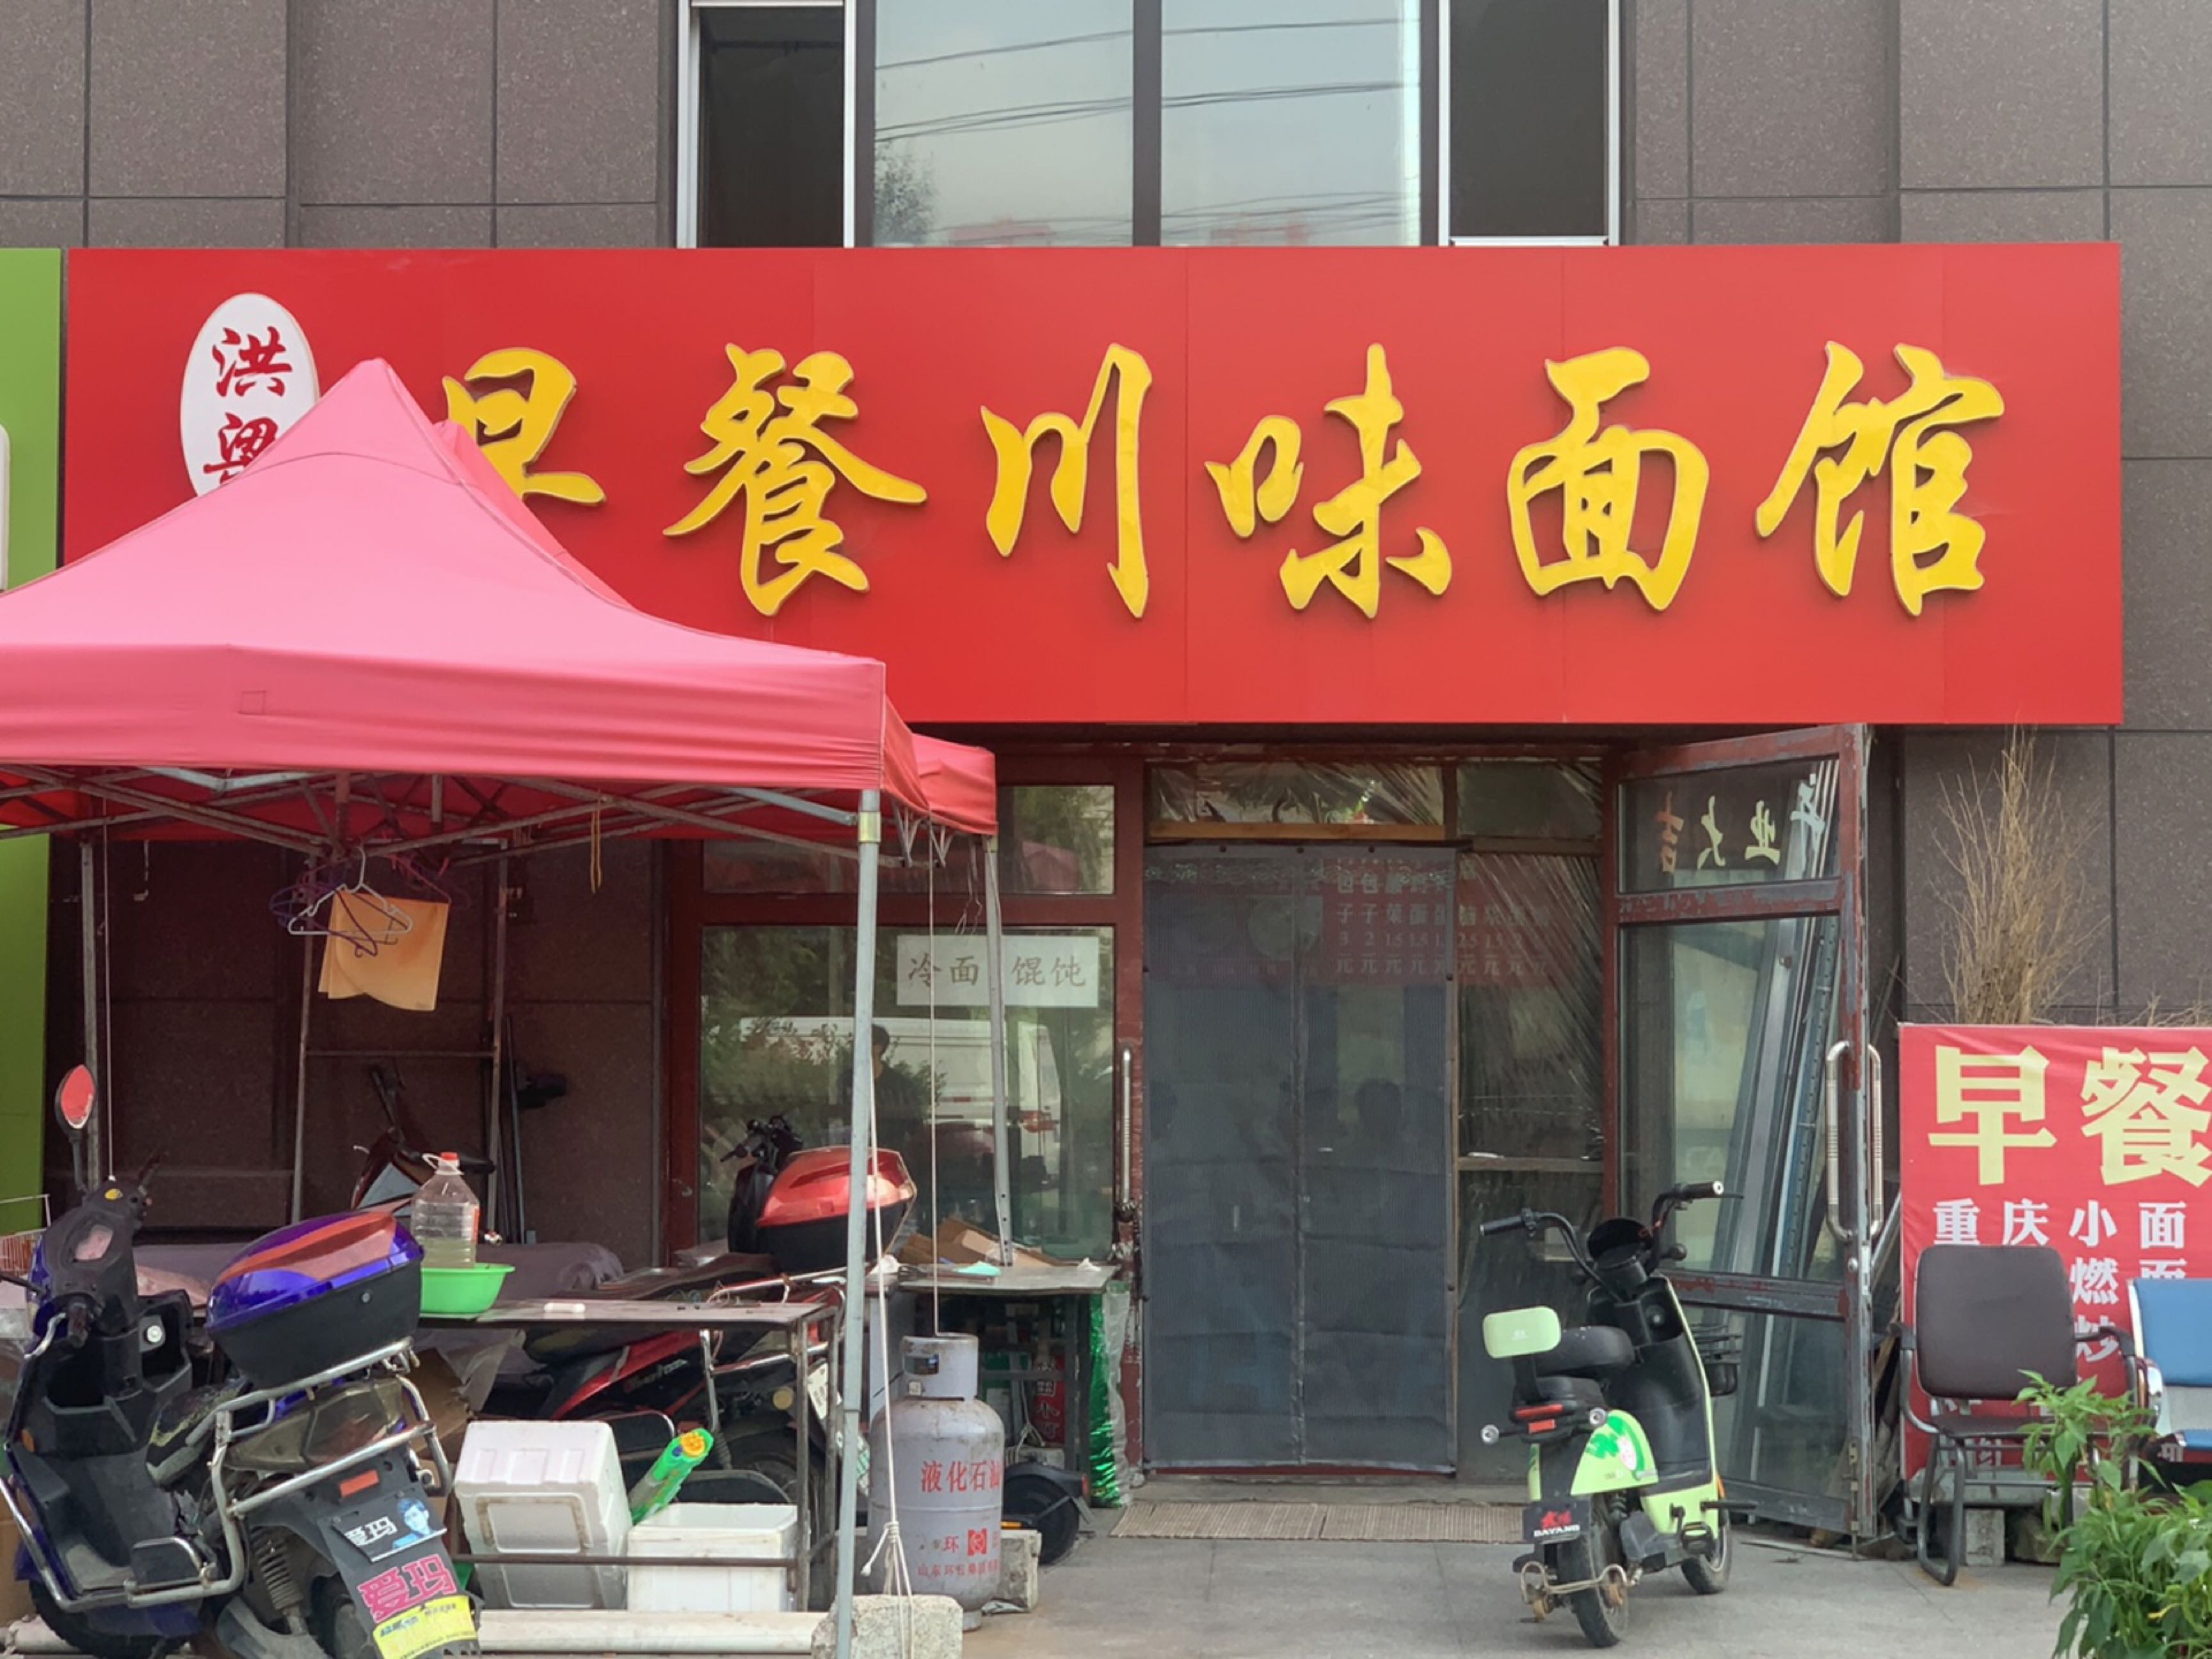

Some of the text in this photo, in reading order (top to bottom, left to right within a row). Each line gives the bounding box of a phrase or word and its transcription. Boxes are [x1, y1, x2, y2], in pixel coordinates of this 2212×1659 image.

[443, 341, 2005, 617] 早餐川味面馆
[908, 953, 1087, 988] 冷面 馄饨
[1928, 1045, 2212, 1188] 早餐
[1932, 1199, 2187, 1250] 重庆小面
[344, 1516, 397, 1546] 爱玛
[357, 1553, 457, 1624] 爱玛
